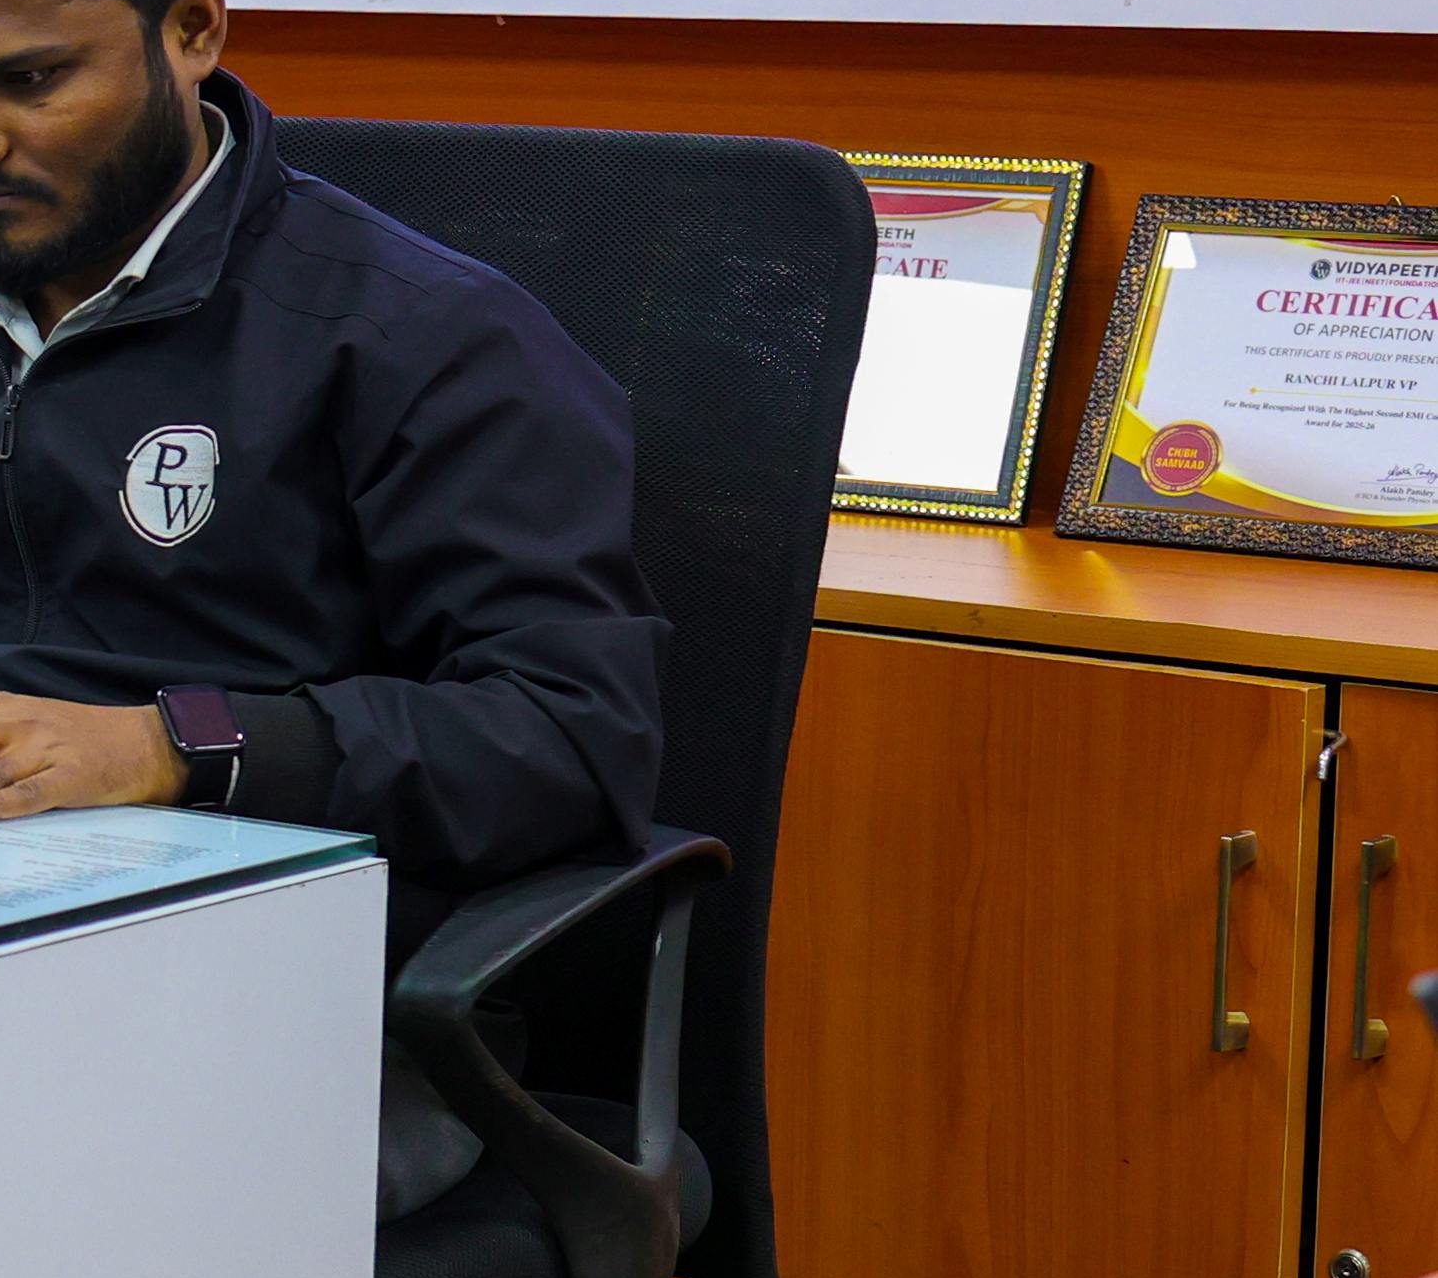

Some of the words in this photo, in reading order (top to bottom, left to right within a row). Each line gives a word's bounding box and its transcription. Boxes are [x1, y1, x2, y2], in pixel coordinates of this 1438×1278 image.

[1293, 323, 1315, 335] OF
[1318, 324, 1434, 342] APPRECIATION
[1244, 345, 1267, 355] THIS
[1269, 347, 1330, 359] CERTIFICATE
[1334, 350, 1343, 359] IS
[1345, 350, 1393, 362] PROUDLY
[1285, 373, 1339, 386] RANCHI
[1341, 376, 1395, 390] LALPUR
[1399, 379, 1417, 390] VP
[1155, 457, 1205, 470] SAMVAAD
[145, 440, 209, 532] PW
[1406, 488, 1434, 497] Pandey
